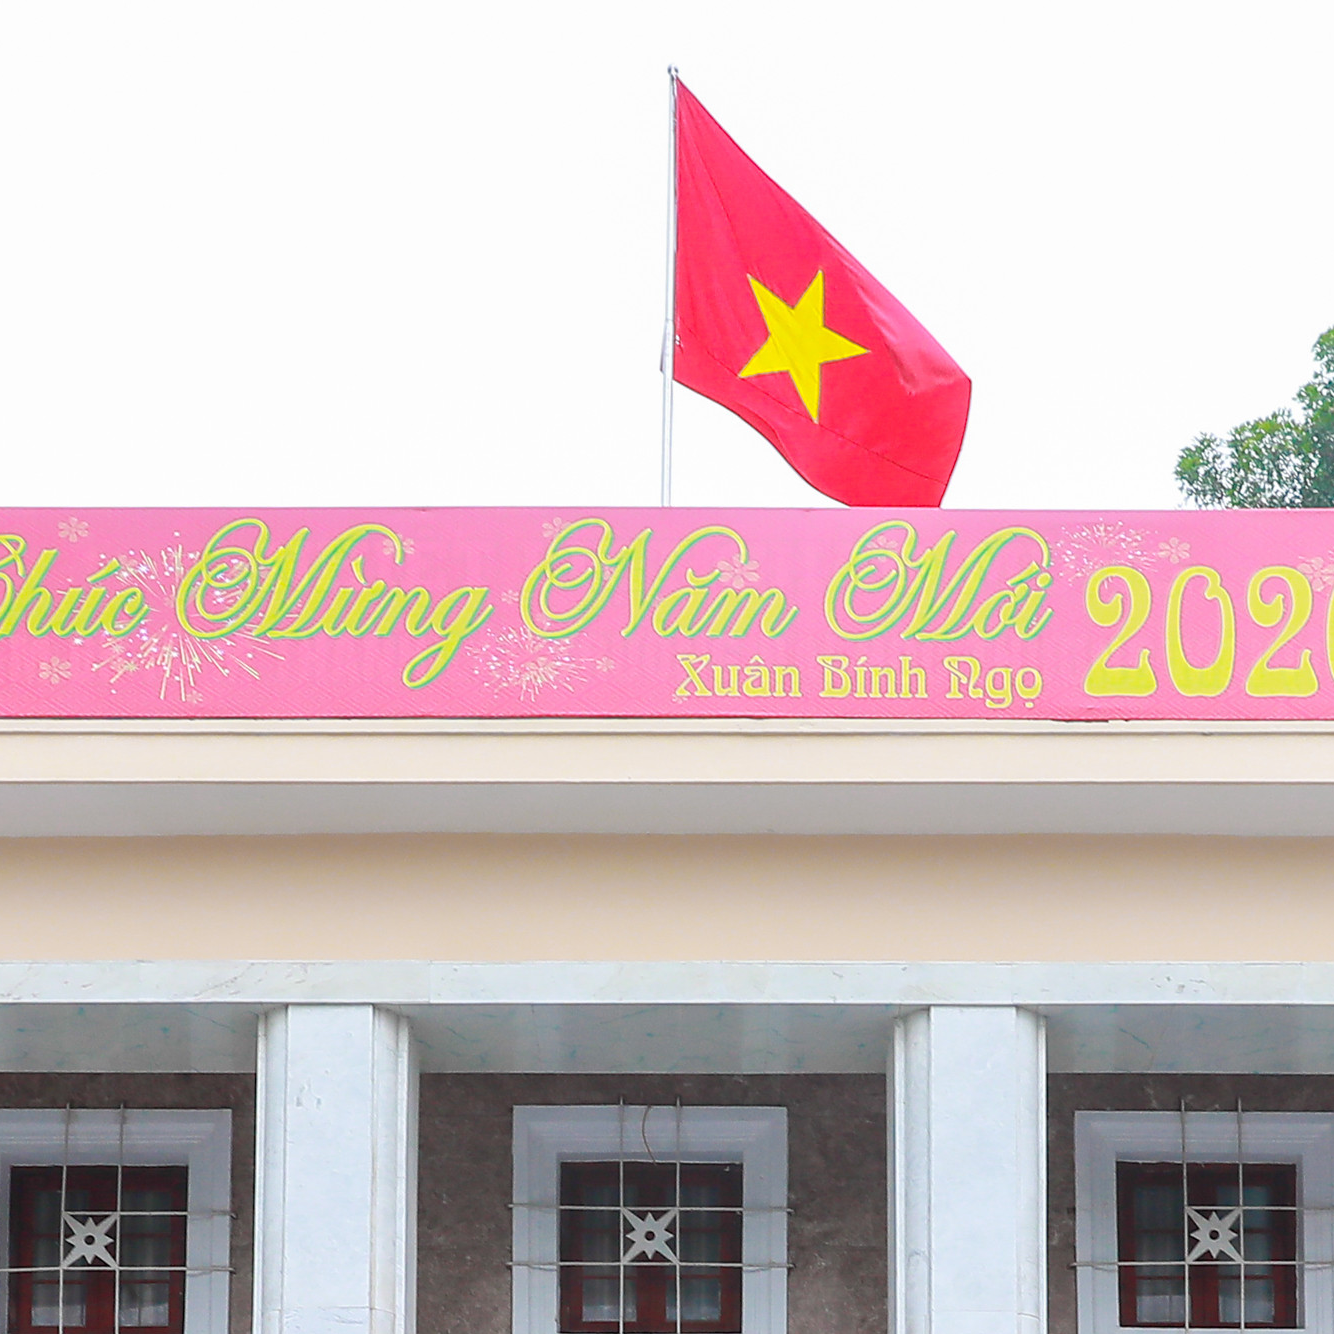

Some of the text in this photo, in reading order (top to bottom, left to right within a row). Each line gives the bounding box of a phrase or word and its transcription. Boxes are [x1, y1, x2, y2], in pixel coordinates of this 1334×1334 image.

[174, 517, 495, 689] Mừng
[519, 517, 799, 640] Năm
[824, 519, 1055, 641] Mới
[675, 653, 1044, 709] Xuân Bính Ngọ
